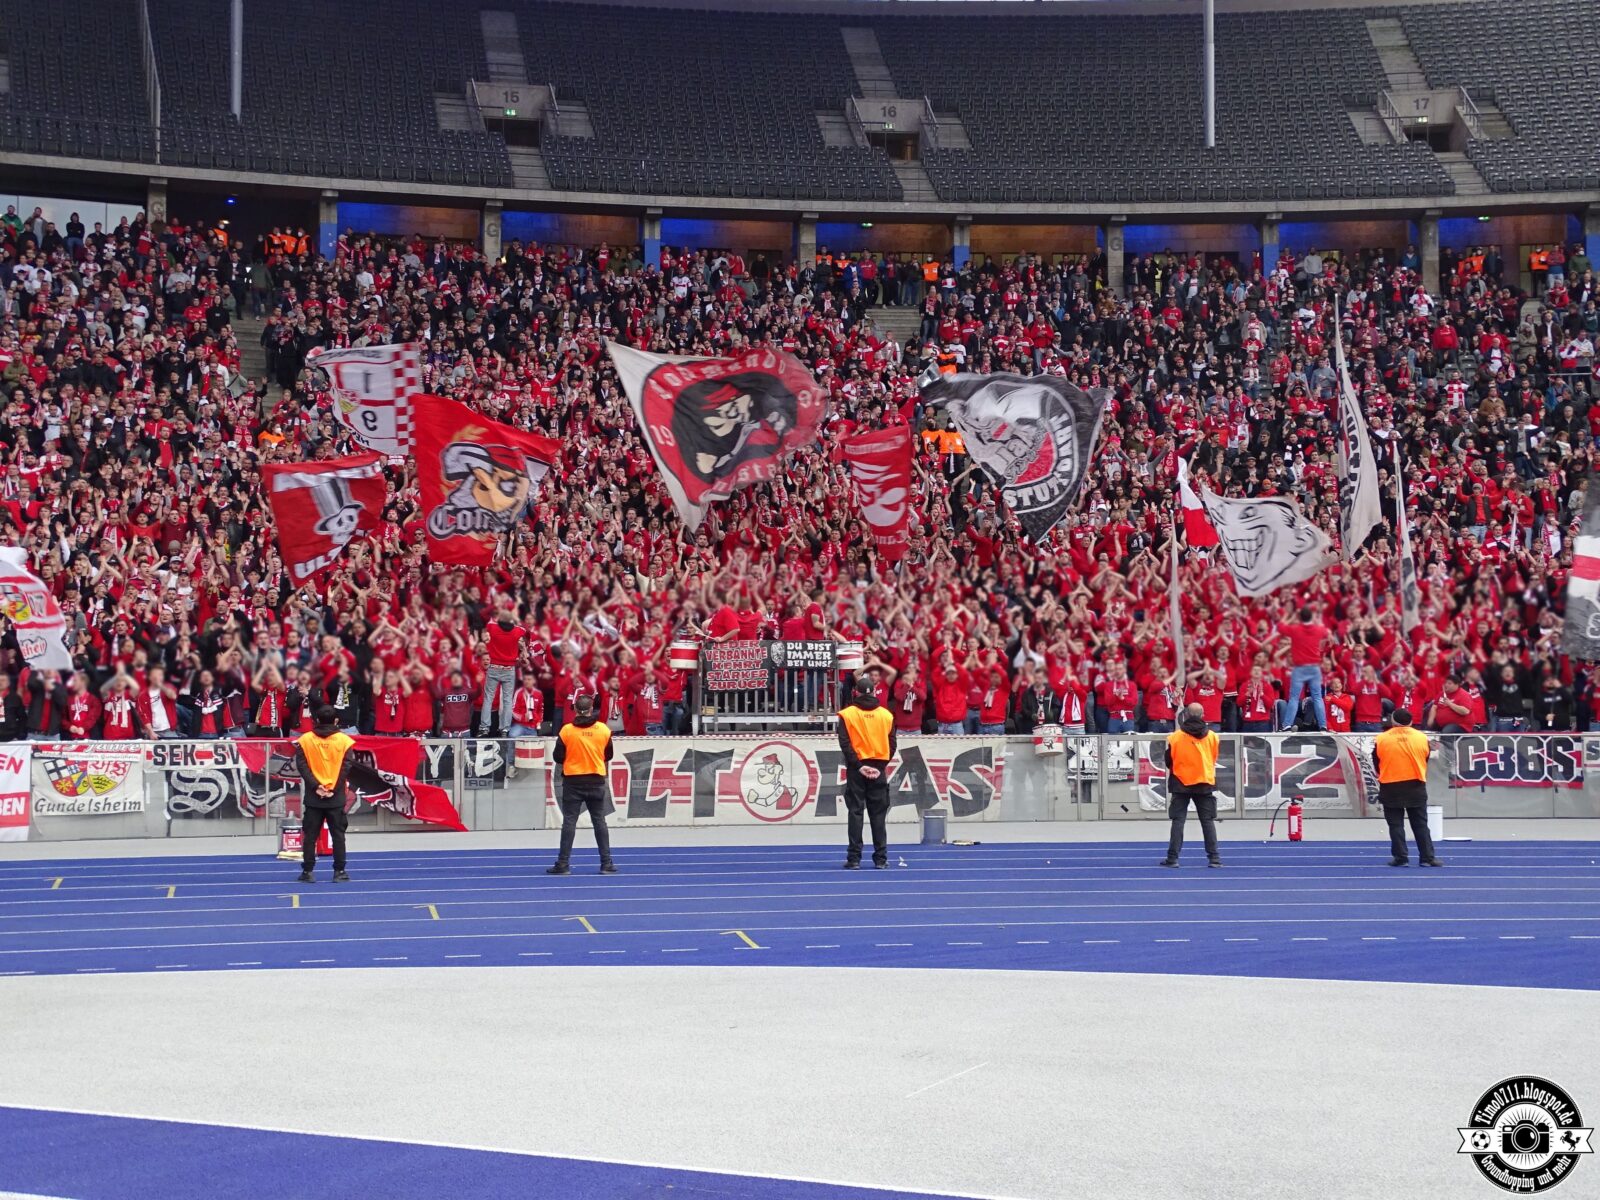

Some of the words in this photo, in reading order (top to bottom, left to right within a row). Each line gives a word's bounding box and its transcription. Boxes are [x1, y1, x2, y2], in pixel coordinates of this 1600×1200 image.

[502, 91, 520, 103] 15
[1413, 97, 1430, 110] 17
[881, 105, 898, 118] 16
[1110, 236, 1123, 251] G
[650, 424, 676, 448] 19
[712, 640, 761, 650] JEDER
[786, 642, 803, 650] DU
[806, 643, 832, 651] BIST
[705, 646, 768, 662] VERBANNTE
[786, 650, 832, 660] IMMER
[711, 660, 763, 671] KEHRT
[786, 659, 804, 667] BEI
[807, 660, 833, 668] UNS!
[707, 668, 769, 681] STÄRKER
[708, 678, 768, 691] ZURÜCK
[153, 743, 205, 766] SEK.
[35, 797, 142, 813] Gundelsheim
